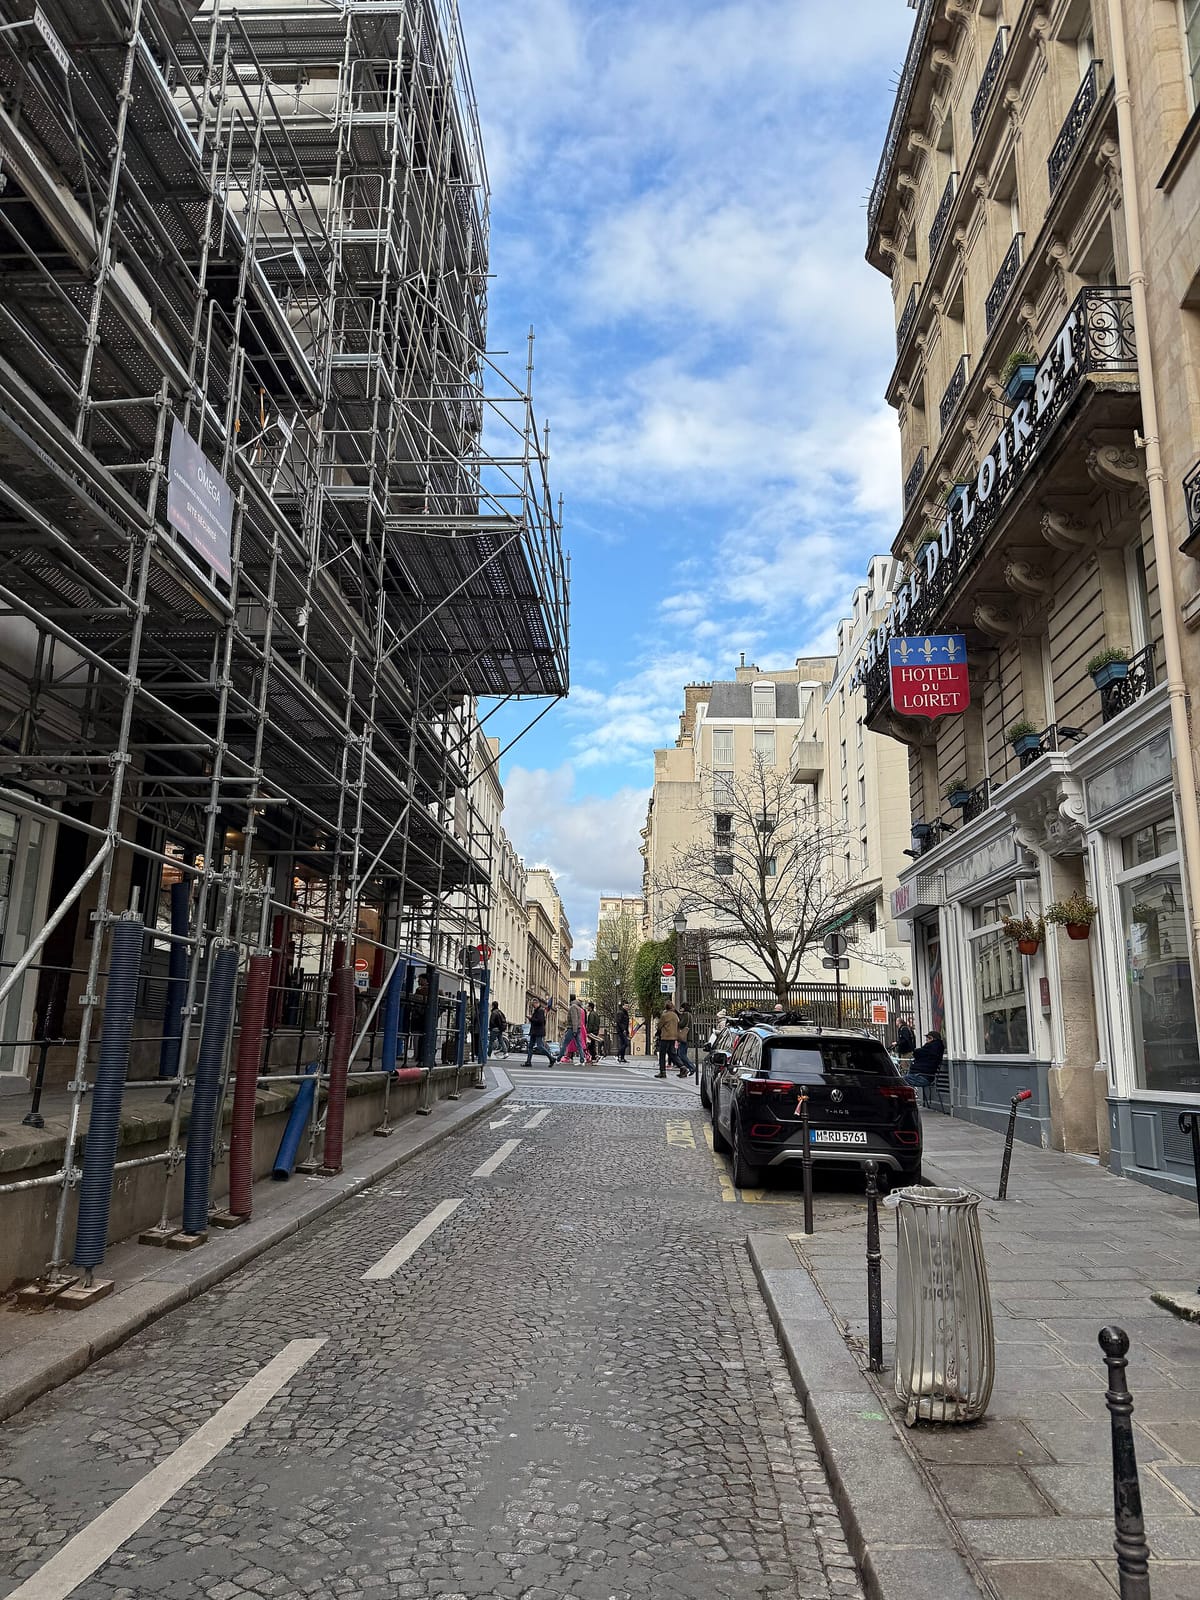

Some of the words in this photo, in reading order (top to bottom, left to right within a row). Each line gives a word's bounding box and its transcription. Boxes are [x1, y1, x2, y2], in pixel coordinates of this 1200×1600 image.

[197, 466, 222, 507] OMEGA
[866, 569, 921, 674] HOTEL
[926, 513, 954, 584] DU
[961, 312, 1079, 532] LOIRET
[902, 666, 959, 682] HOTEL
[922, 683, 939, 692] DU
[903, 692, 961, 708] LOIRET
[842, 1131, 866, 1143] 5761
